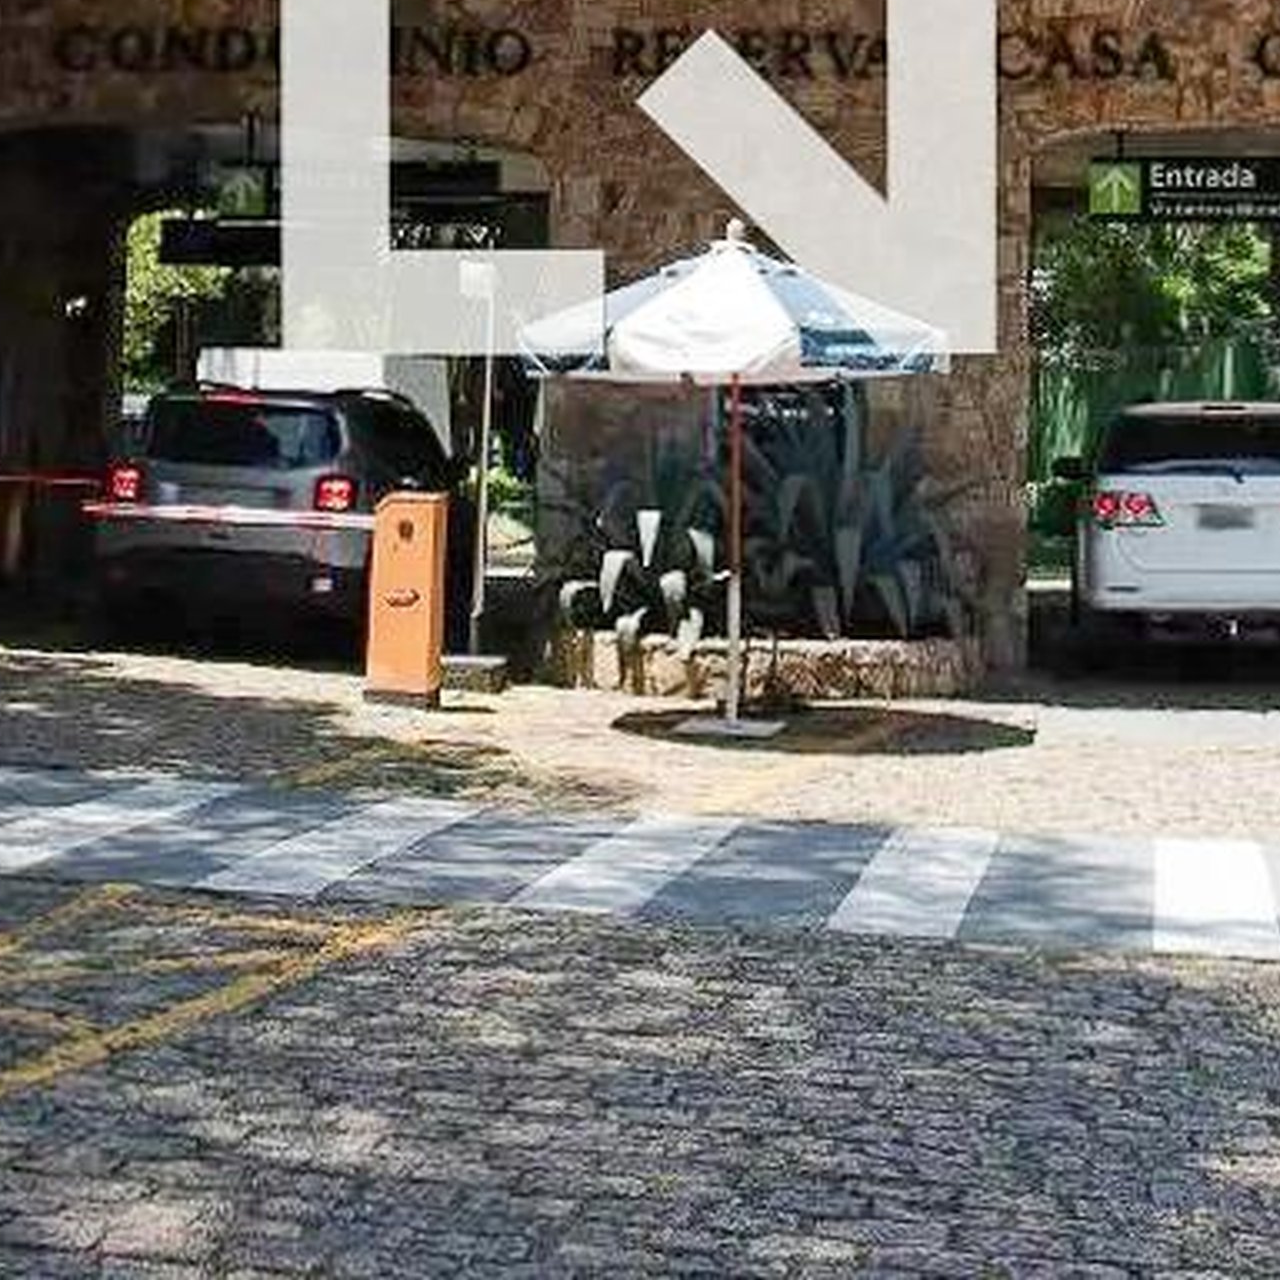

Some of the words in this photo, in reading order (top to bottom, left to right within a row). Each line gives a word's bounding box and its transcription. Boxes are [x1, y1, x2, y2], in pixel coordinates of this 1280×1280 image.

[612, 27, 887, 80] REERVA
[997, 29, 1177, 80] CASA
[1149, 162, 1257, 189] Entrada
